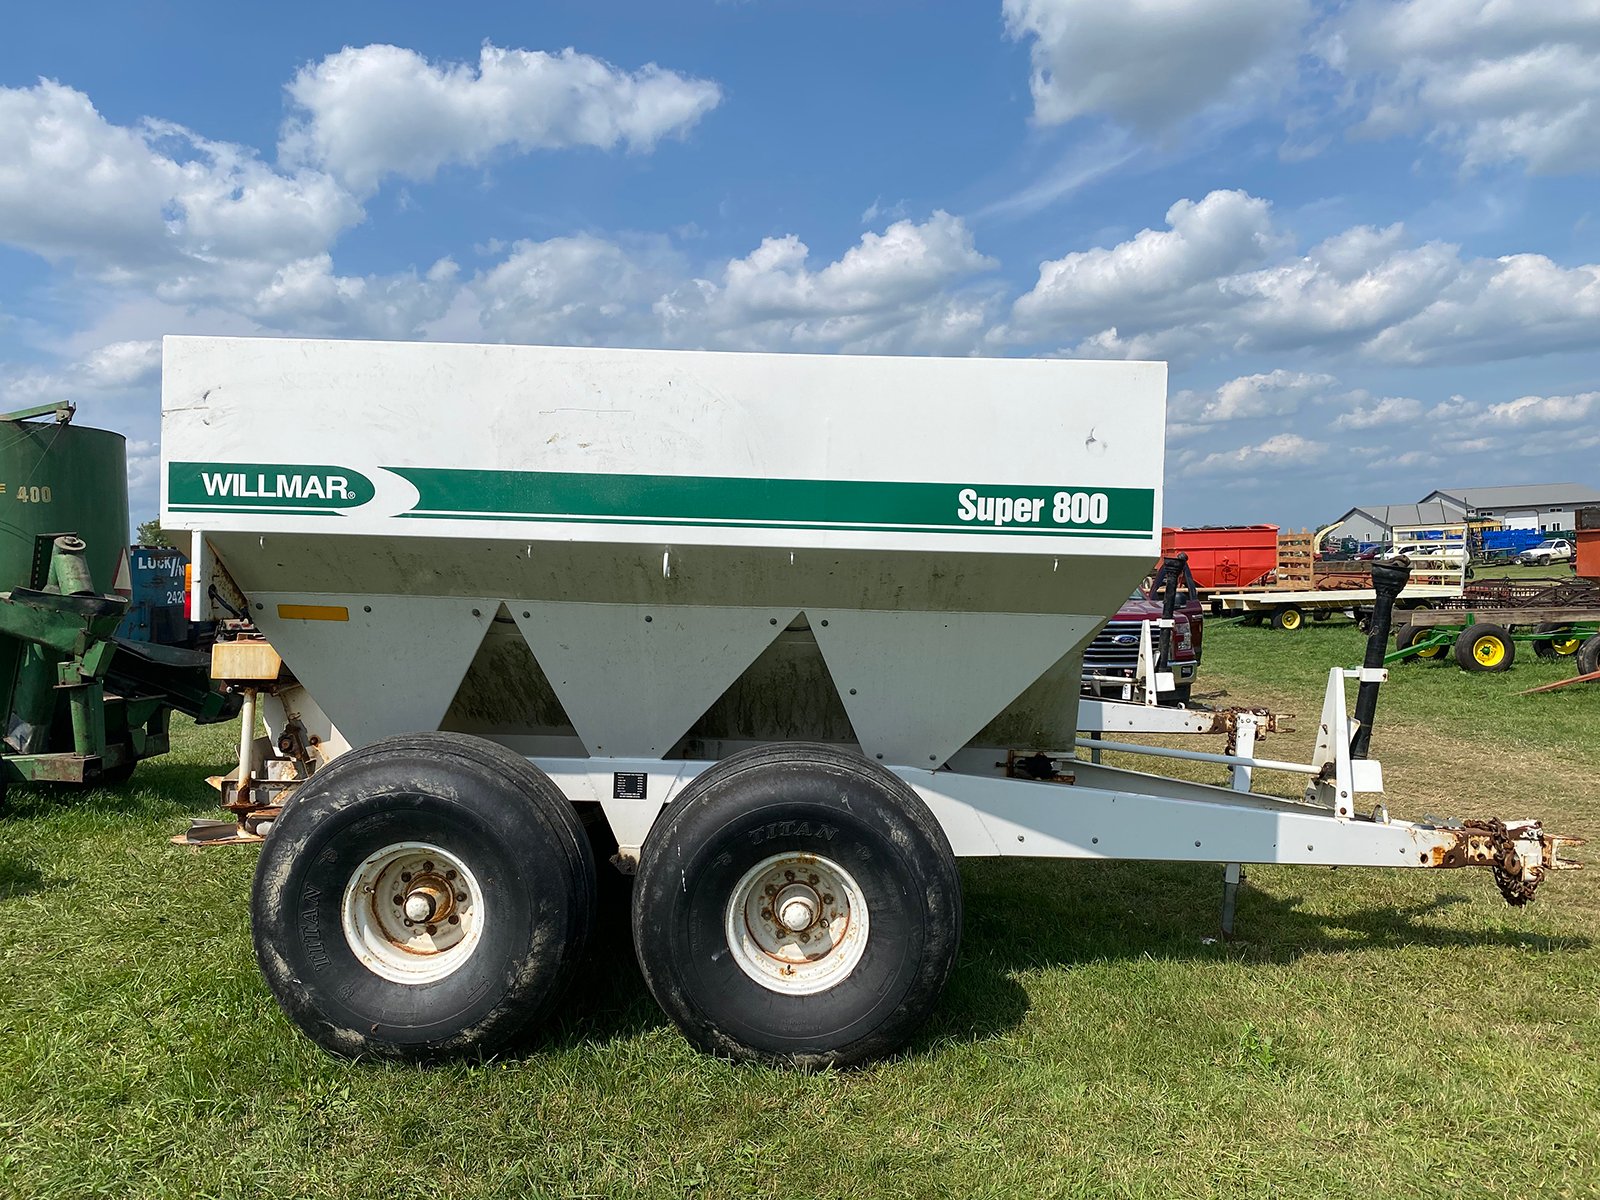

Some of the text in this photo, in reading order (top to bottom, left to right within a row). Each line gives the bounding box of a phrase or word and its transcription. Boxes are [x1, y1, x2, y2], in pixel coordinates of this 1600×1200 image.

[17, 486, 51, 503] 400
[957, 488, 1109, 526] Super 800
[749, 820, 839, 845] TITAN
[301, 883, 332, 972] TITAN
